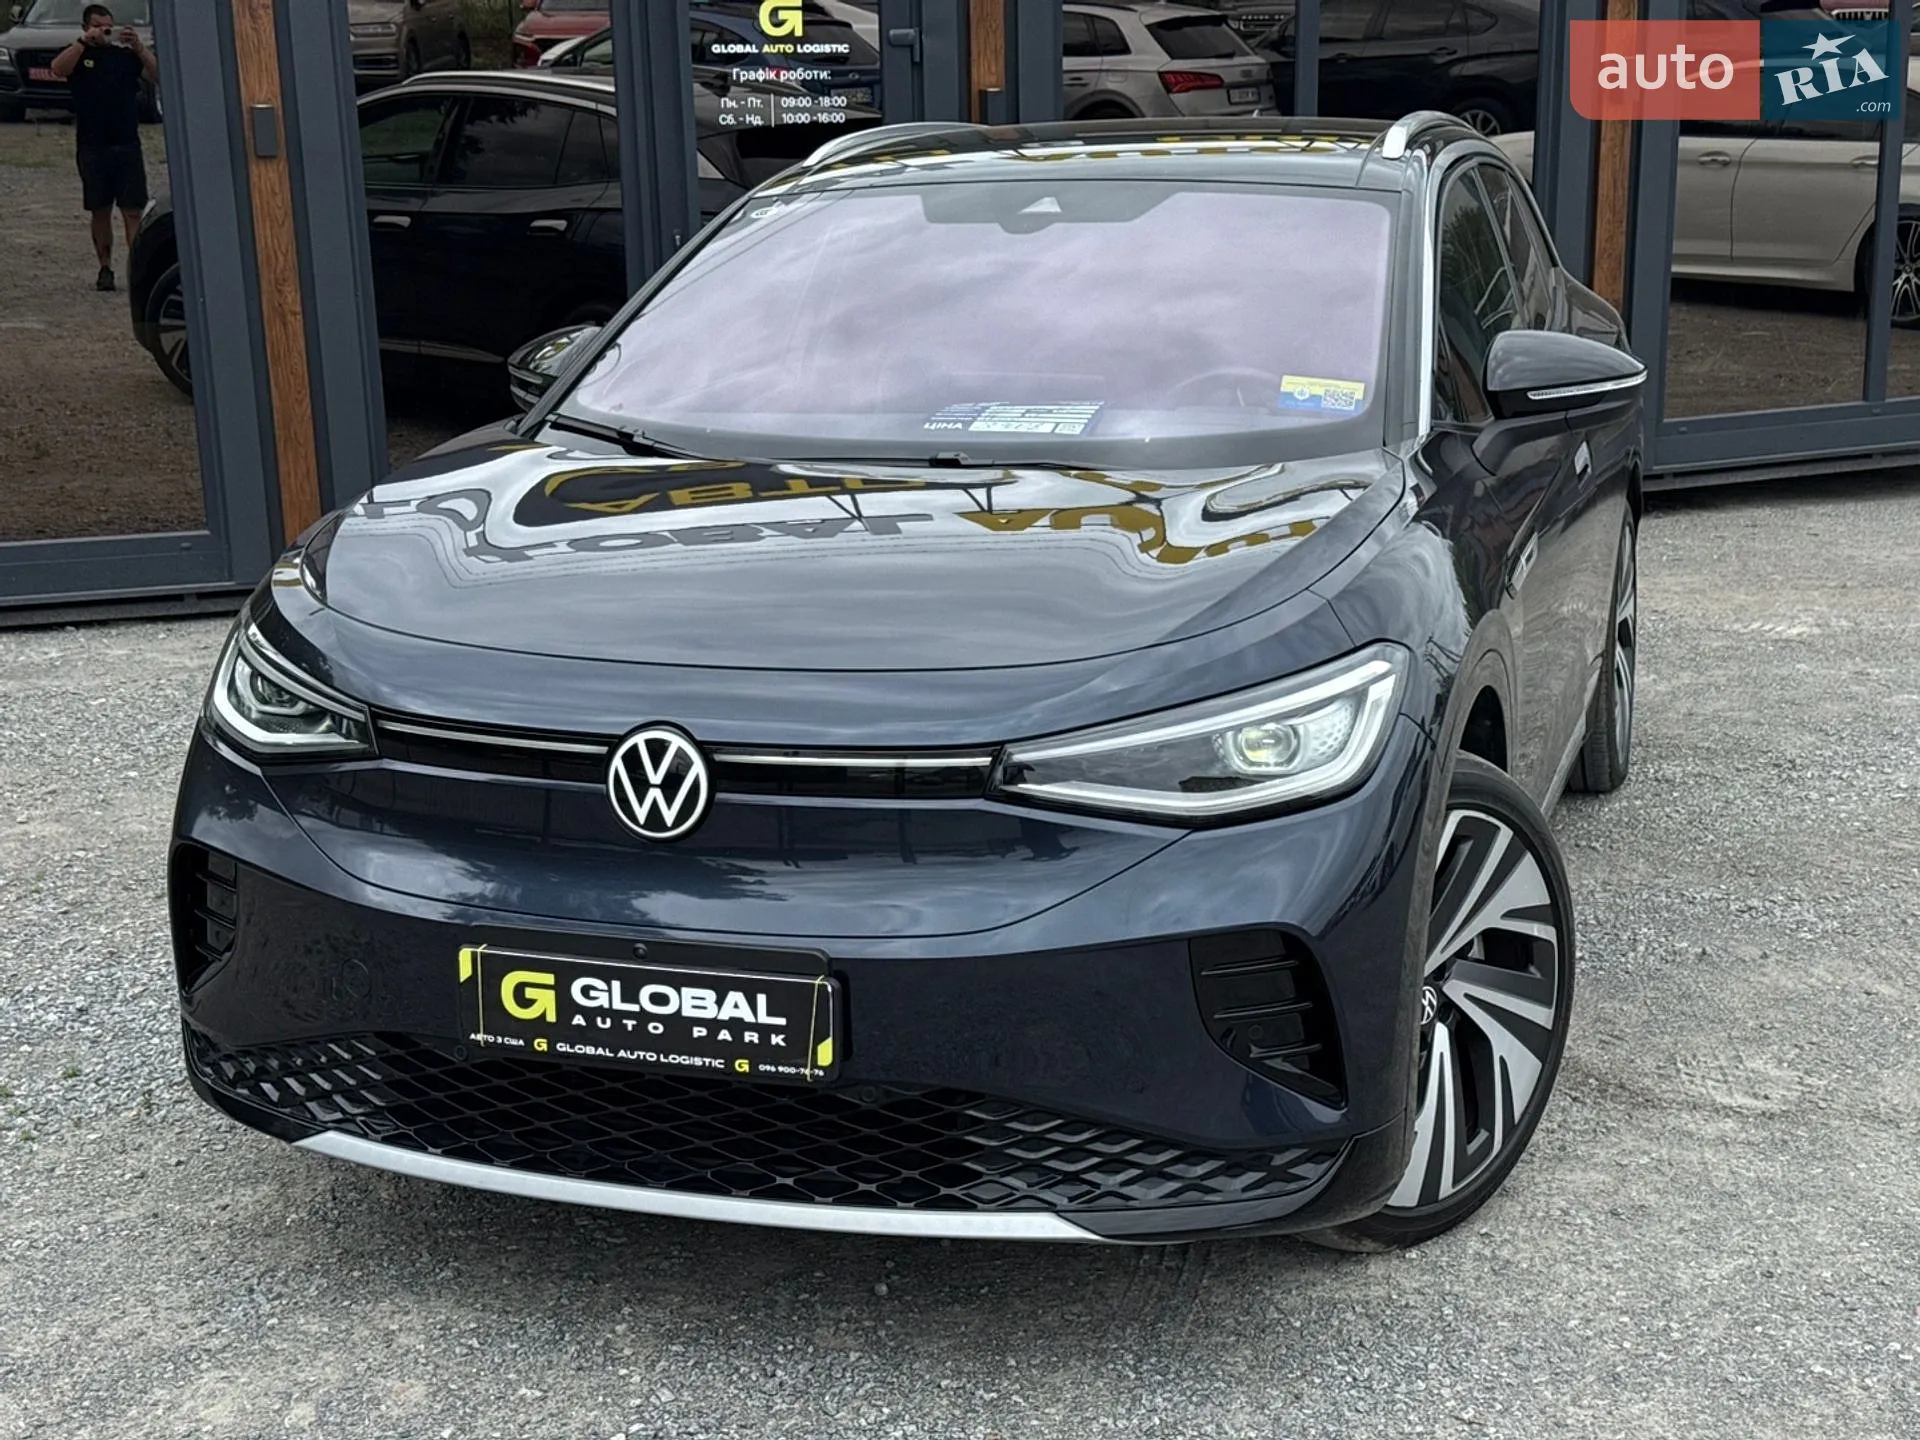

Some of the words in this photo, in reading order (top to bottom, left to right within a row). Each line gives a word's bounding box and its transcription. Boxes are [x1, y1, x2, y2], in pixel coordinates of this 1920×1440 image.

[711, 44, 759, 53] GLOBAL
[762, 44, 794, 53] AUTO
[797, 44, 850, 53] LOGISTIC
[732, 67, 777, 83] Графік
[780, 67, 832, 82] роботи:
[720, 97, 738, 109] Пн.
[747, 97, 764, 108] Пт.
[781, 96, 812, 108] 09:00
[719, 114, 738, 125] Сб.
[746, 114, 764, 126] Нд.
[782, 113, 811, 124] 10:00
[570, 977, 787, 1026] GLOBAL
[571, 1014, 665, 1035] AUTO
[692, 1026, 787, 1047] PARK
[556, 1042, 615, 1057] GLOBAL
[617, 1049, 658, 1062] AUTO
[659, 1053, 726, 1069] LOGISTIC
